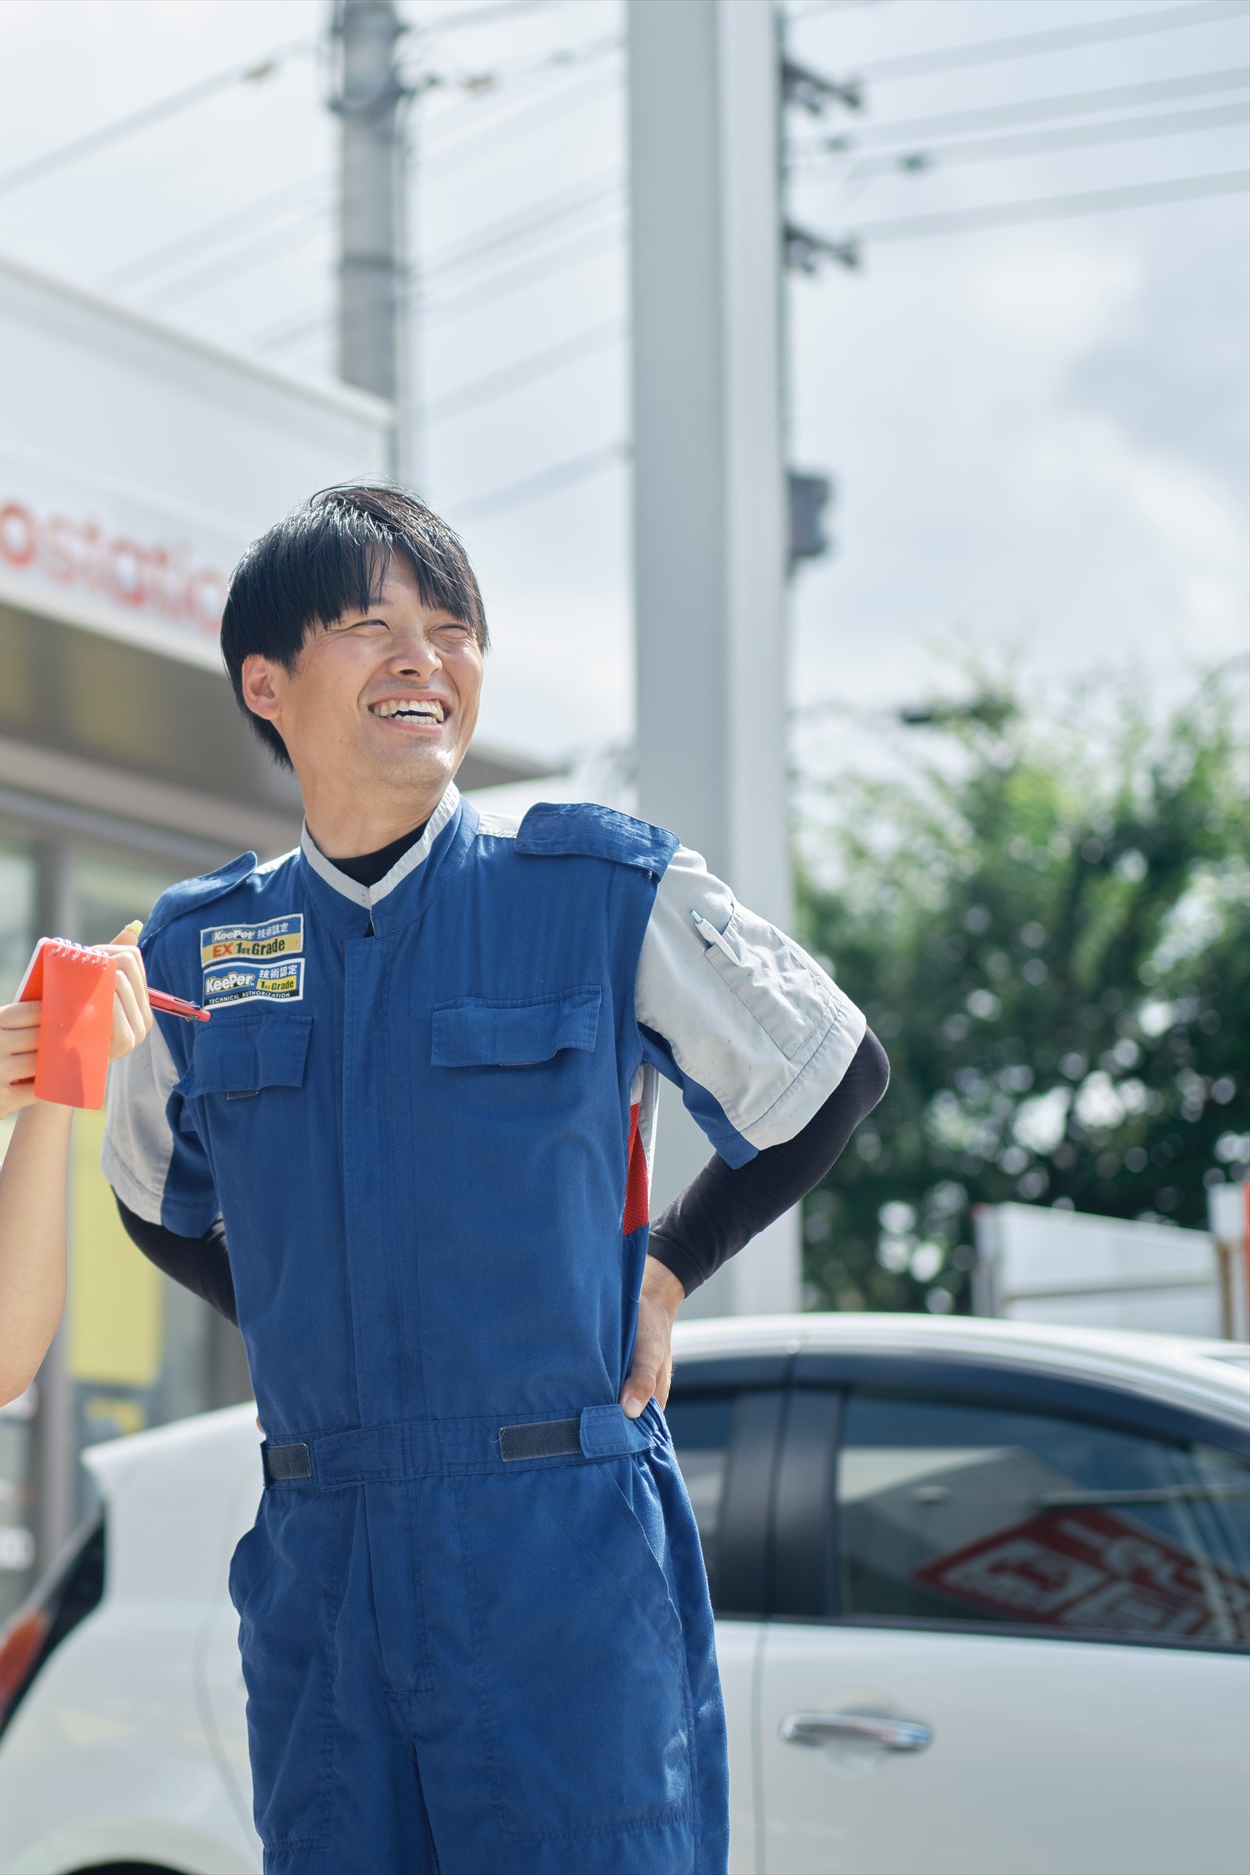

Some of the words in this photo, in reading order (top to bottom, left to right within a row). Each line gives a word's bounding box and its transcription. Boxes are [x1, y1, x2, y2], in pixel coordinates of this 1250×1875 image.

[213, 929, 255, 942] KeePer
[257, 922, 288, 939] 技術認定
[213, 942, 233, 957] EX
[252, 938, 285, 955] Grade
[259, 964, 297, 979] 技術認定
[271, 979, 294, 990] Grade
[208, 993, 240, 1005] TECHNICAL
[242, 990, 290, 998] AUTHORIZATION
